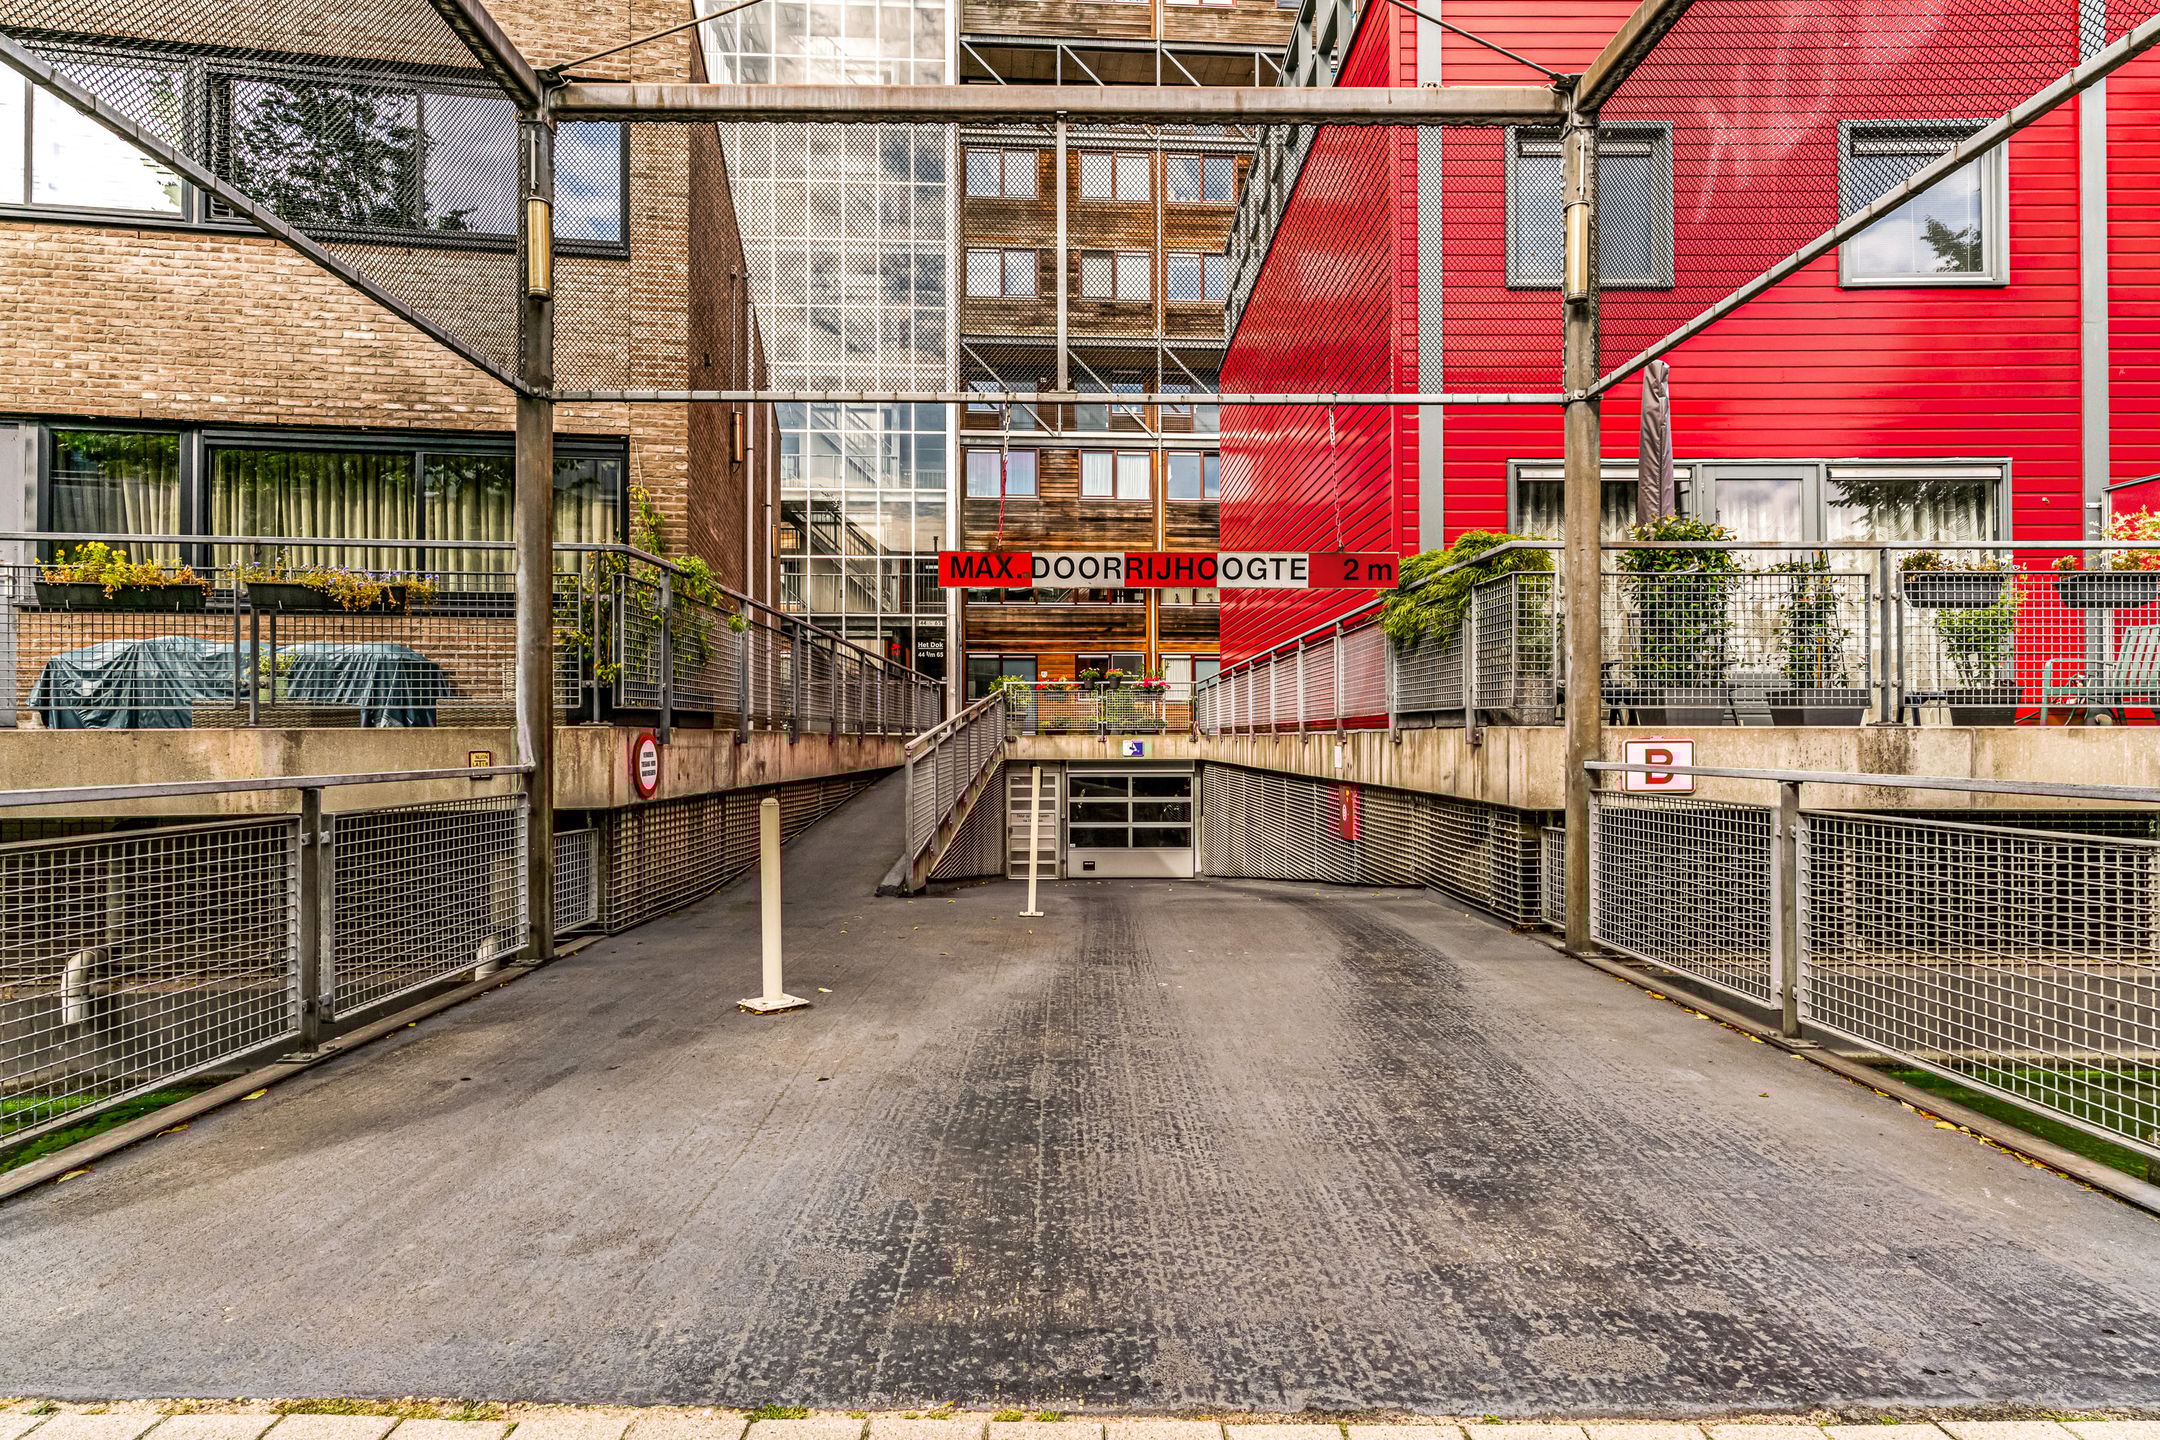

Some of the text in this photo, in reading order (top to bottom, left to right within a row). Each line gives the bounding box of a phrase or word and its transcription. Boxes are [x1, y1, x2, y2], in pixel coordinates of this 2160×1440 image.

[951, 556, 1391, 581] MAX. DOORRIJHOOGTE 2 m
[1645, 748, 1674, 784] B
